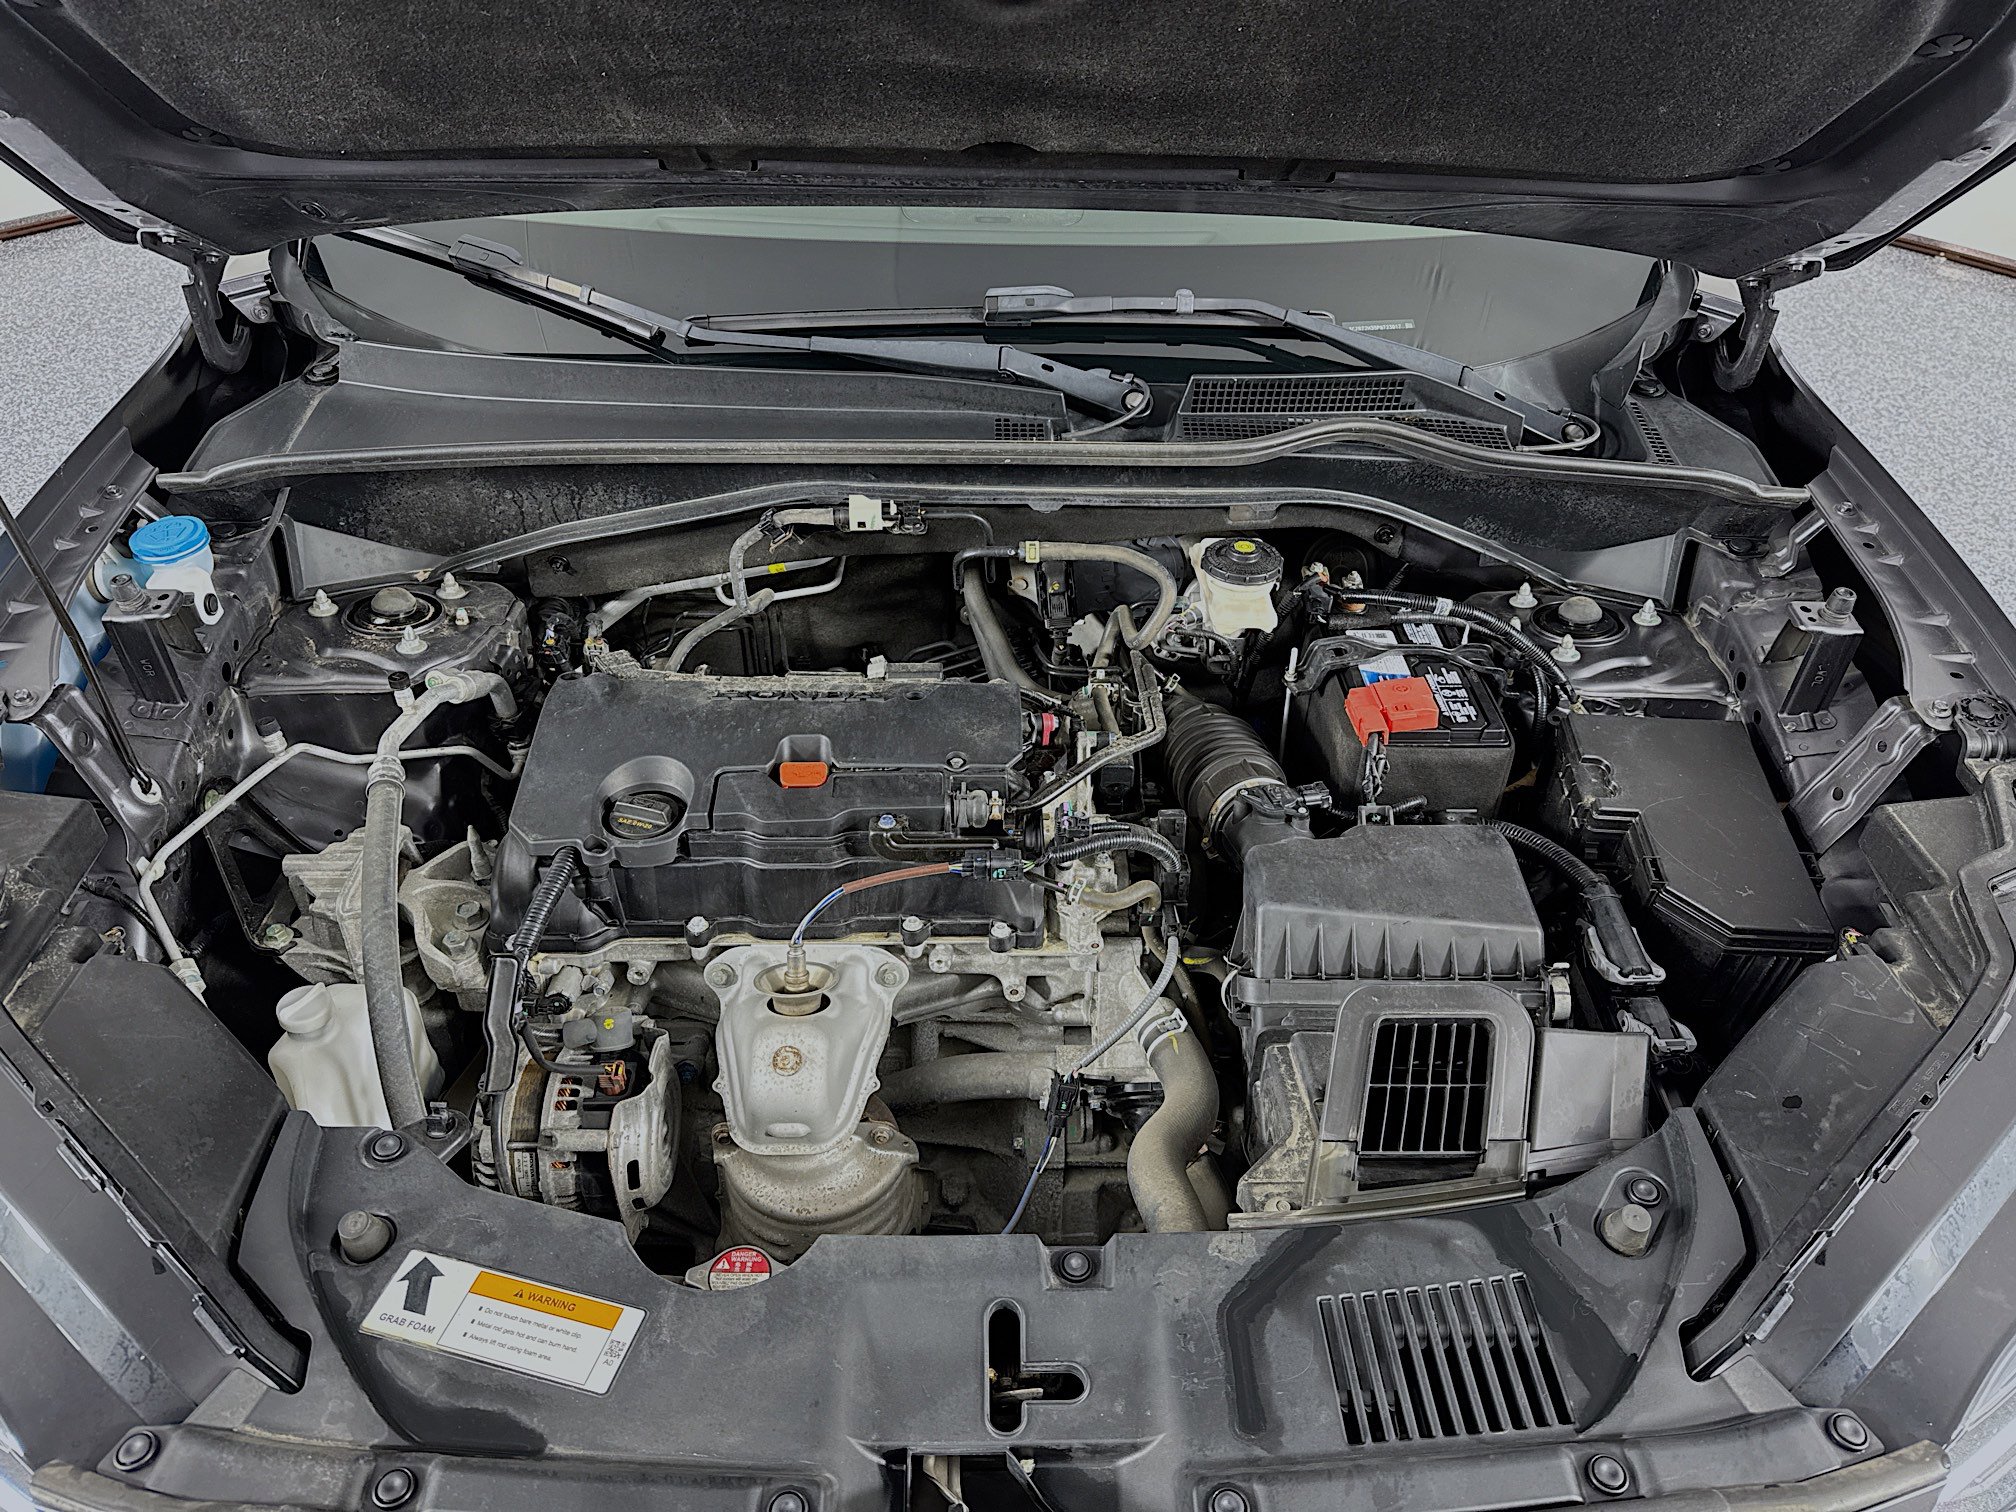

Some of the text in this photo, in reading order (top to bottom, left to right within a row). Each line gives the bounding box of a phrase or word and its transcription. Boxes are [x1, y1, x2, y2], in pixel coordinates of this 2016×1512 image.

[528, 1292, 576, 1311] WARNING
[380, 1313, 436, 1334] GRAB FOAM
[519, 1317, 532, 1325] bare
[532, 1321, 548, 1329] metal
[469, 1333, 488, 1344] Always
[507, 1345, 523, 1354] using
[522, 1348, 538, 1356] foam
[477, 1320, 492, 1329] Metal
[502, 1328, 515, 1336] gets
[548, 1340, 562, 1348] burn
